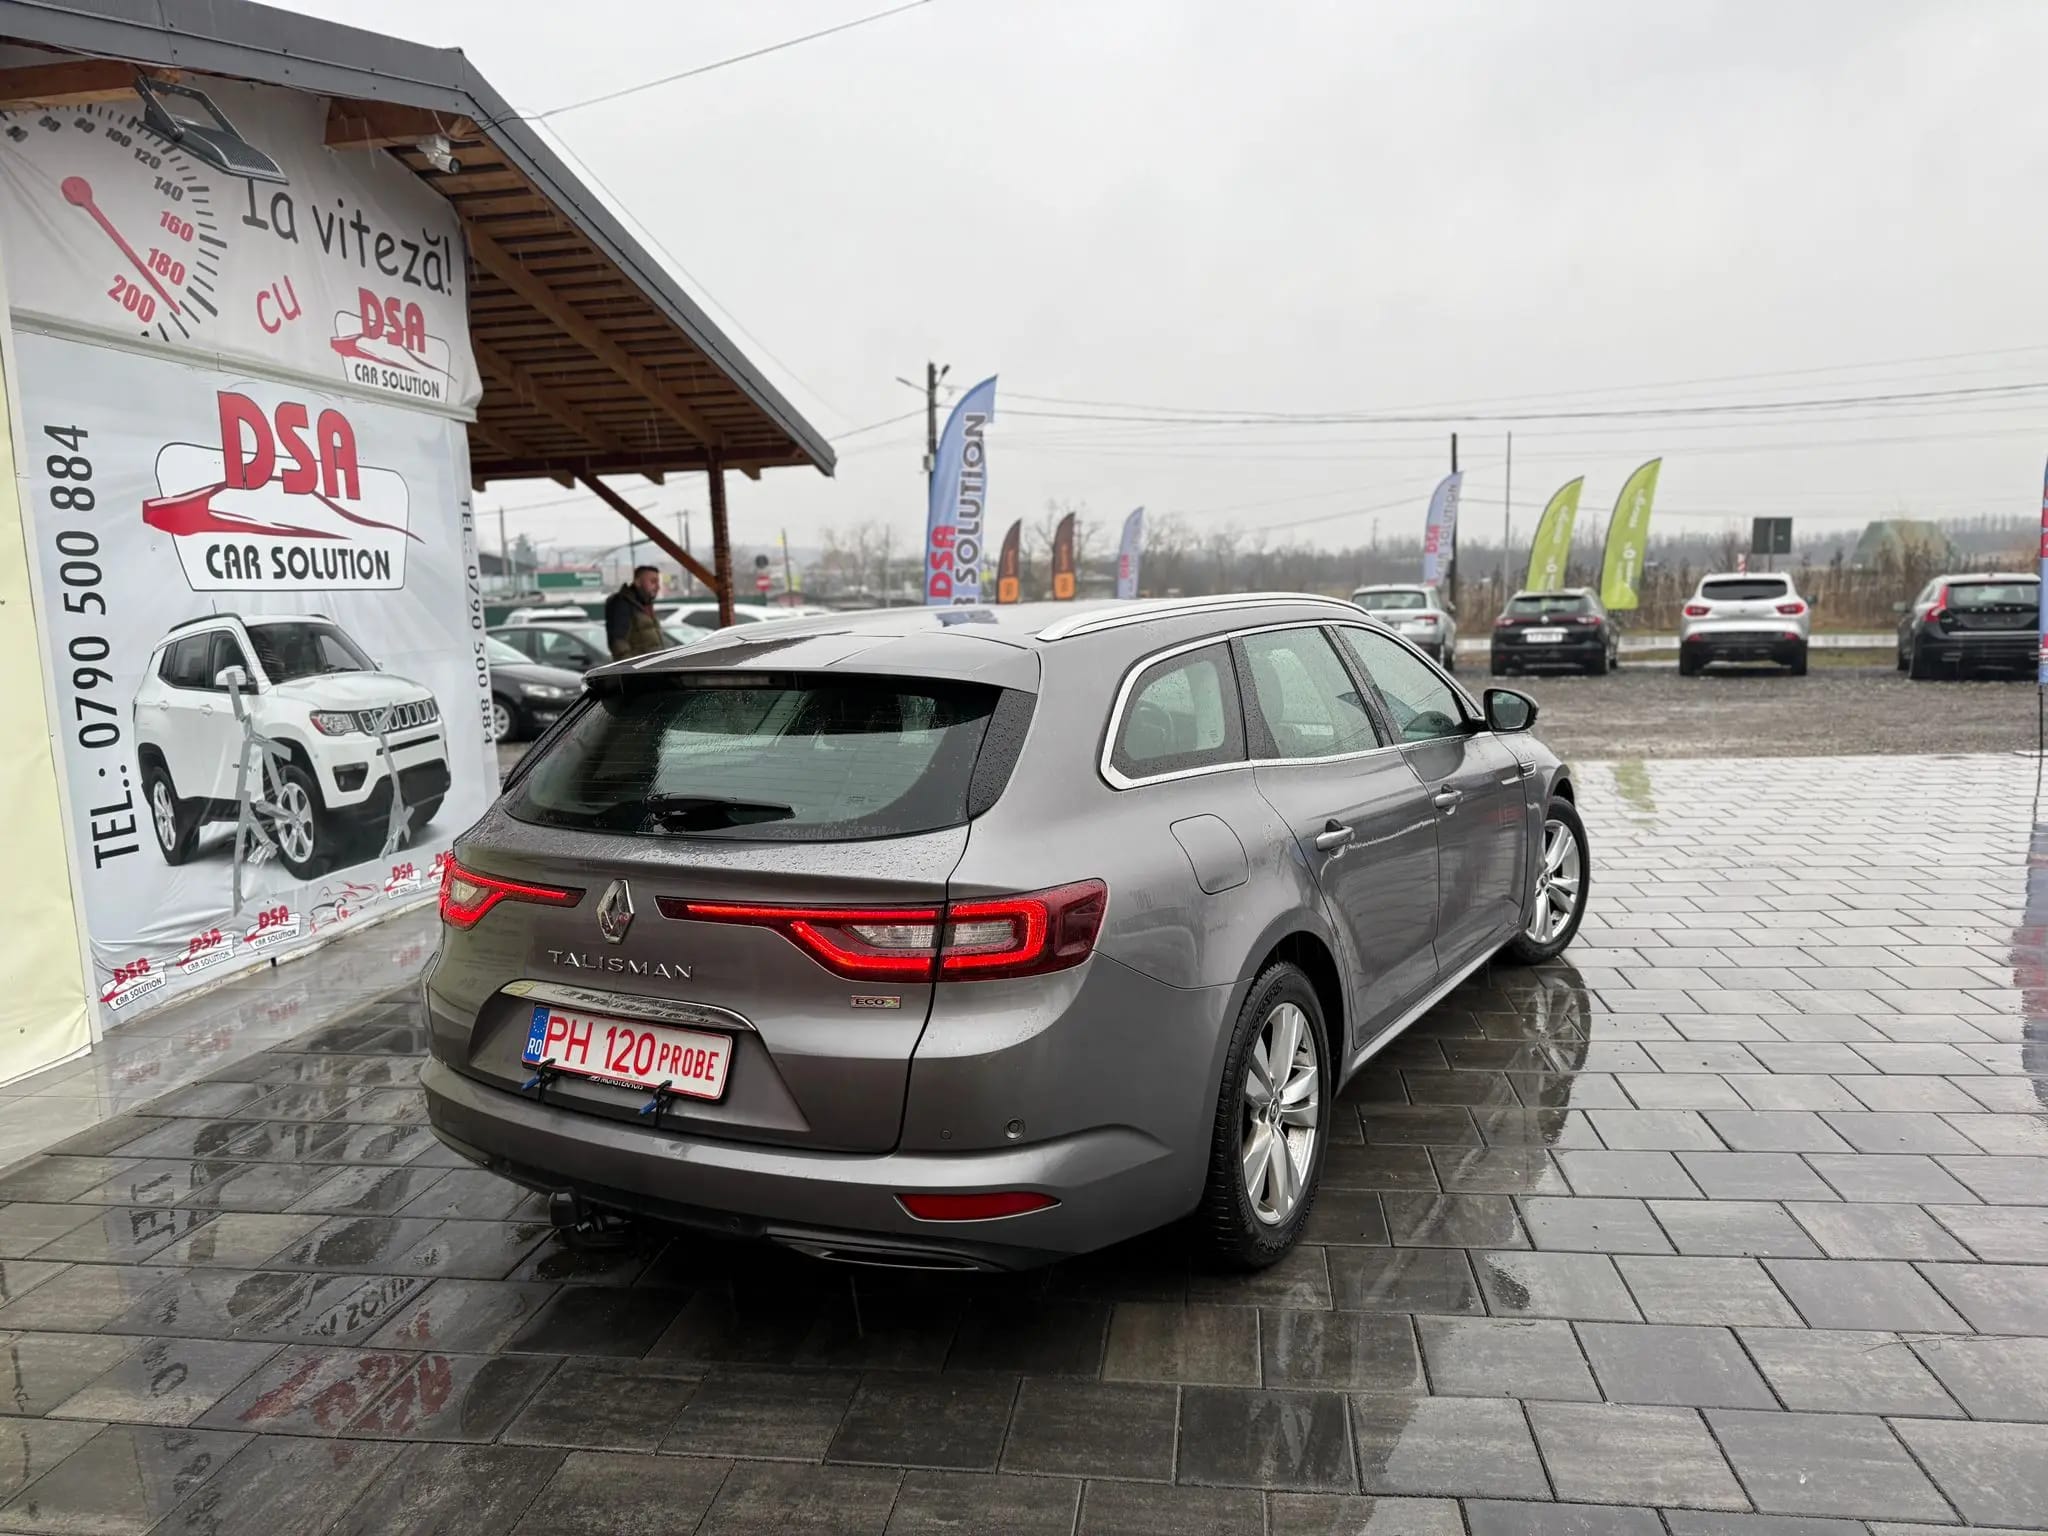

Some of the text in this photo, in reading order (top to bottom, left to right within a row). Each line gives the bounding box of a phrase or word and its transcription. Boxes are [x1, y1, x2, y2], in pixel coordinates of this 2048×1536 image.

[105, 127, 132, 147] 100
[134, 148, 161, 169] 120
[153, 176, 183, 201] 140
[159, 210, 195, 242] 160
[312, 198, 453, 296] viteză!
[146, 248, 186, 286] 180
[107, 274, 156, 323] 200
[358, 288, 426, 353] DSA
[354, 363, 440, 397] CAR SOLUTION
[217, 390, 361, 500] DSA
[44, 424, 96, 512] 884
[955, 415, 986, 584] SOLUTION
[56, 530, 107, 616] 500
[206, 544, 391, 580] CAR SOLUTION
[930, 525, 955, 598] DSA
[467, 565, 481, 630] 0790
[473, 641, 488, 688] 500
[69, 635, 122, 749] 0790
[481, 699, 493, 744] 884
[392, 862, 413, 881] DSA
[258, 905, 289, 928] DSA
[189, 928, 222, 954] DSA
[266, 929, 296, 944] SOLUTION
[114, 958, 151, 985] DSA
[201, 950, 230, 966] SOLUTION
[548, 950, 692, 981] TALISMAN
[115, 977, 162, 1006] CAR SOLUTION
[527, 1038, 543, 1056] RO
[543, 1016, 719, 1081] PH 120 PROBE
